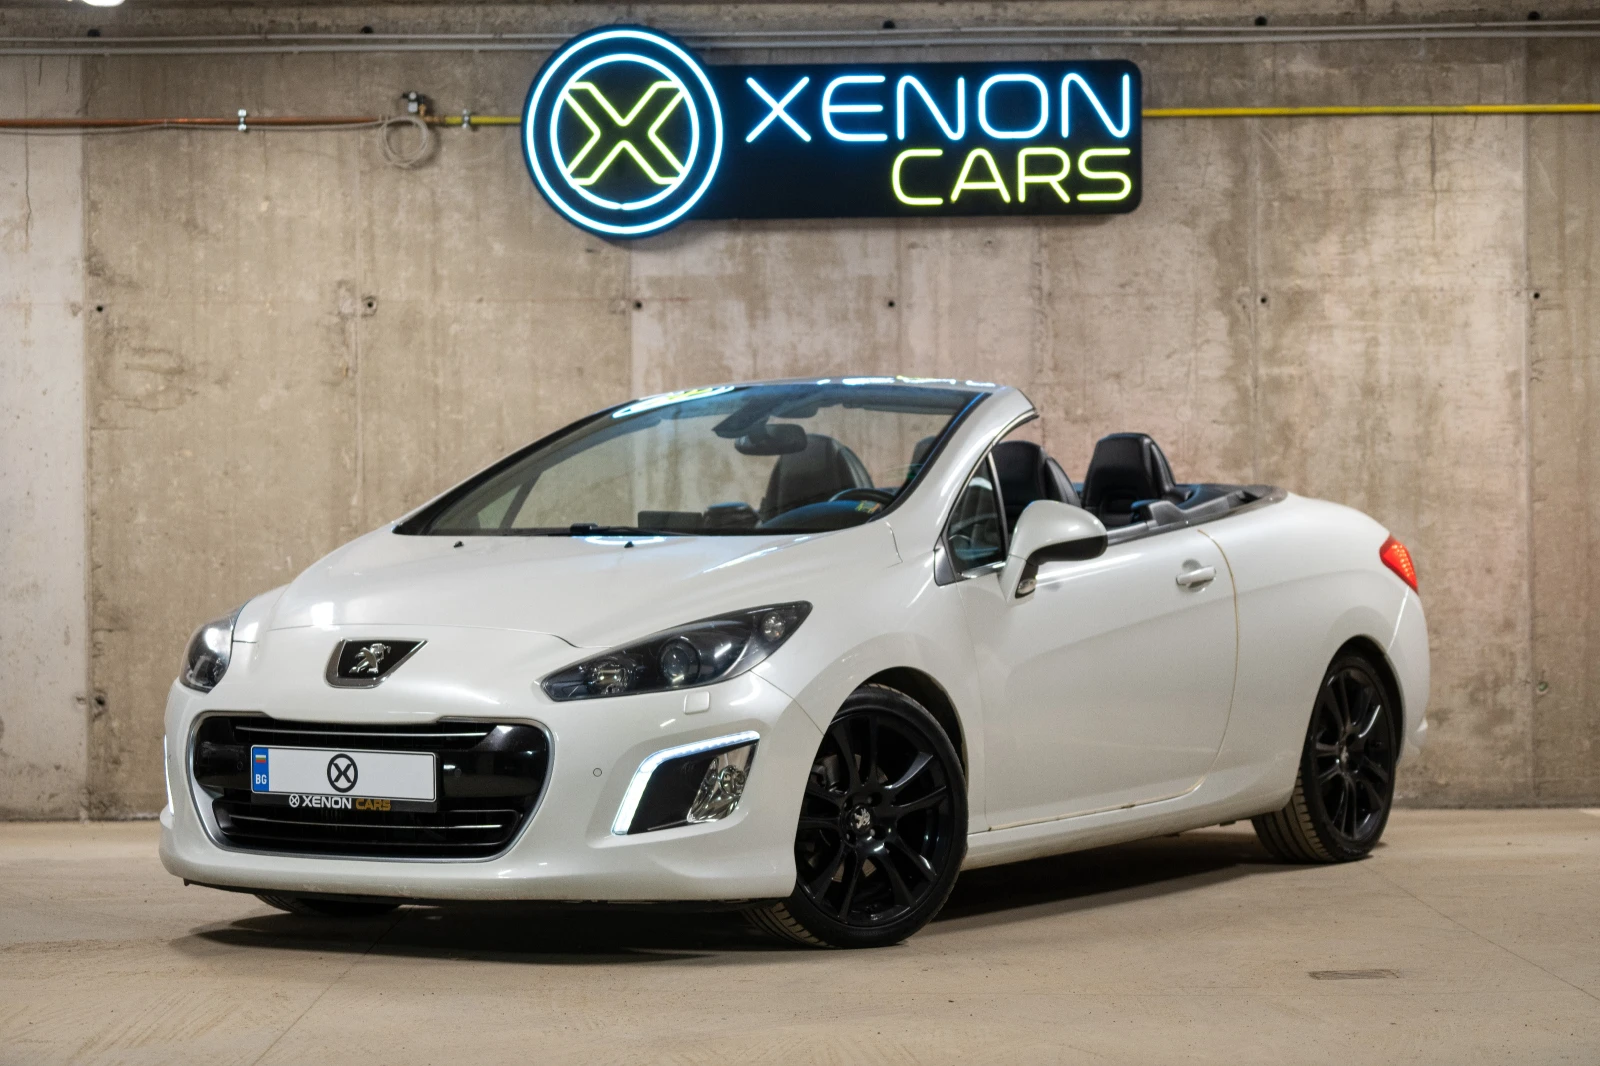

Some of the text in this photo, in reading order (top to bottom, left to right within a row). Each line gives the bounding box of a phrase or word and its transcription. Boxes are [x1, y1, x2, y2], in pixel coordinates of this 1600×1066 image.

[745, 73, 1131, 142] XENON
[892, 147, 1132, 205] CARS
[255, 774, 267, 785] BG
[302, 795, 352, 809] XENON
[355, 799, 391, 811] CARS
